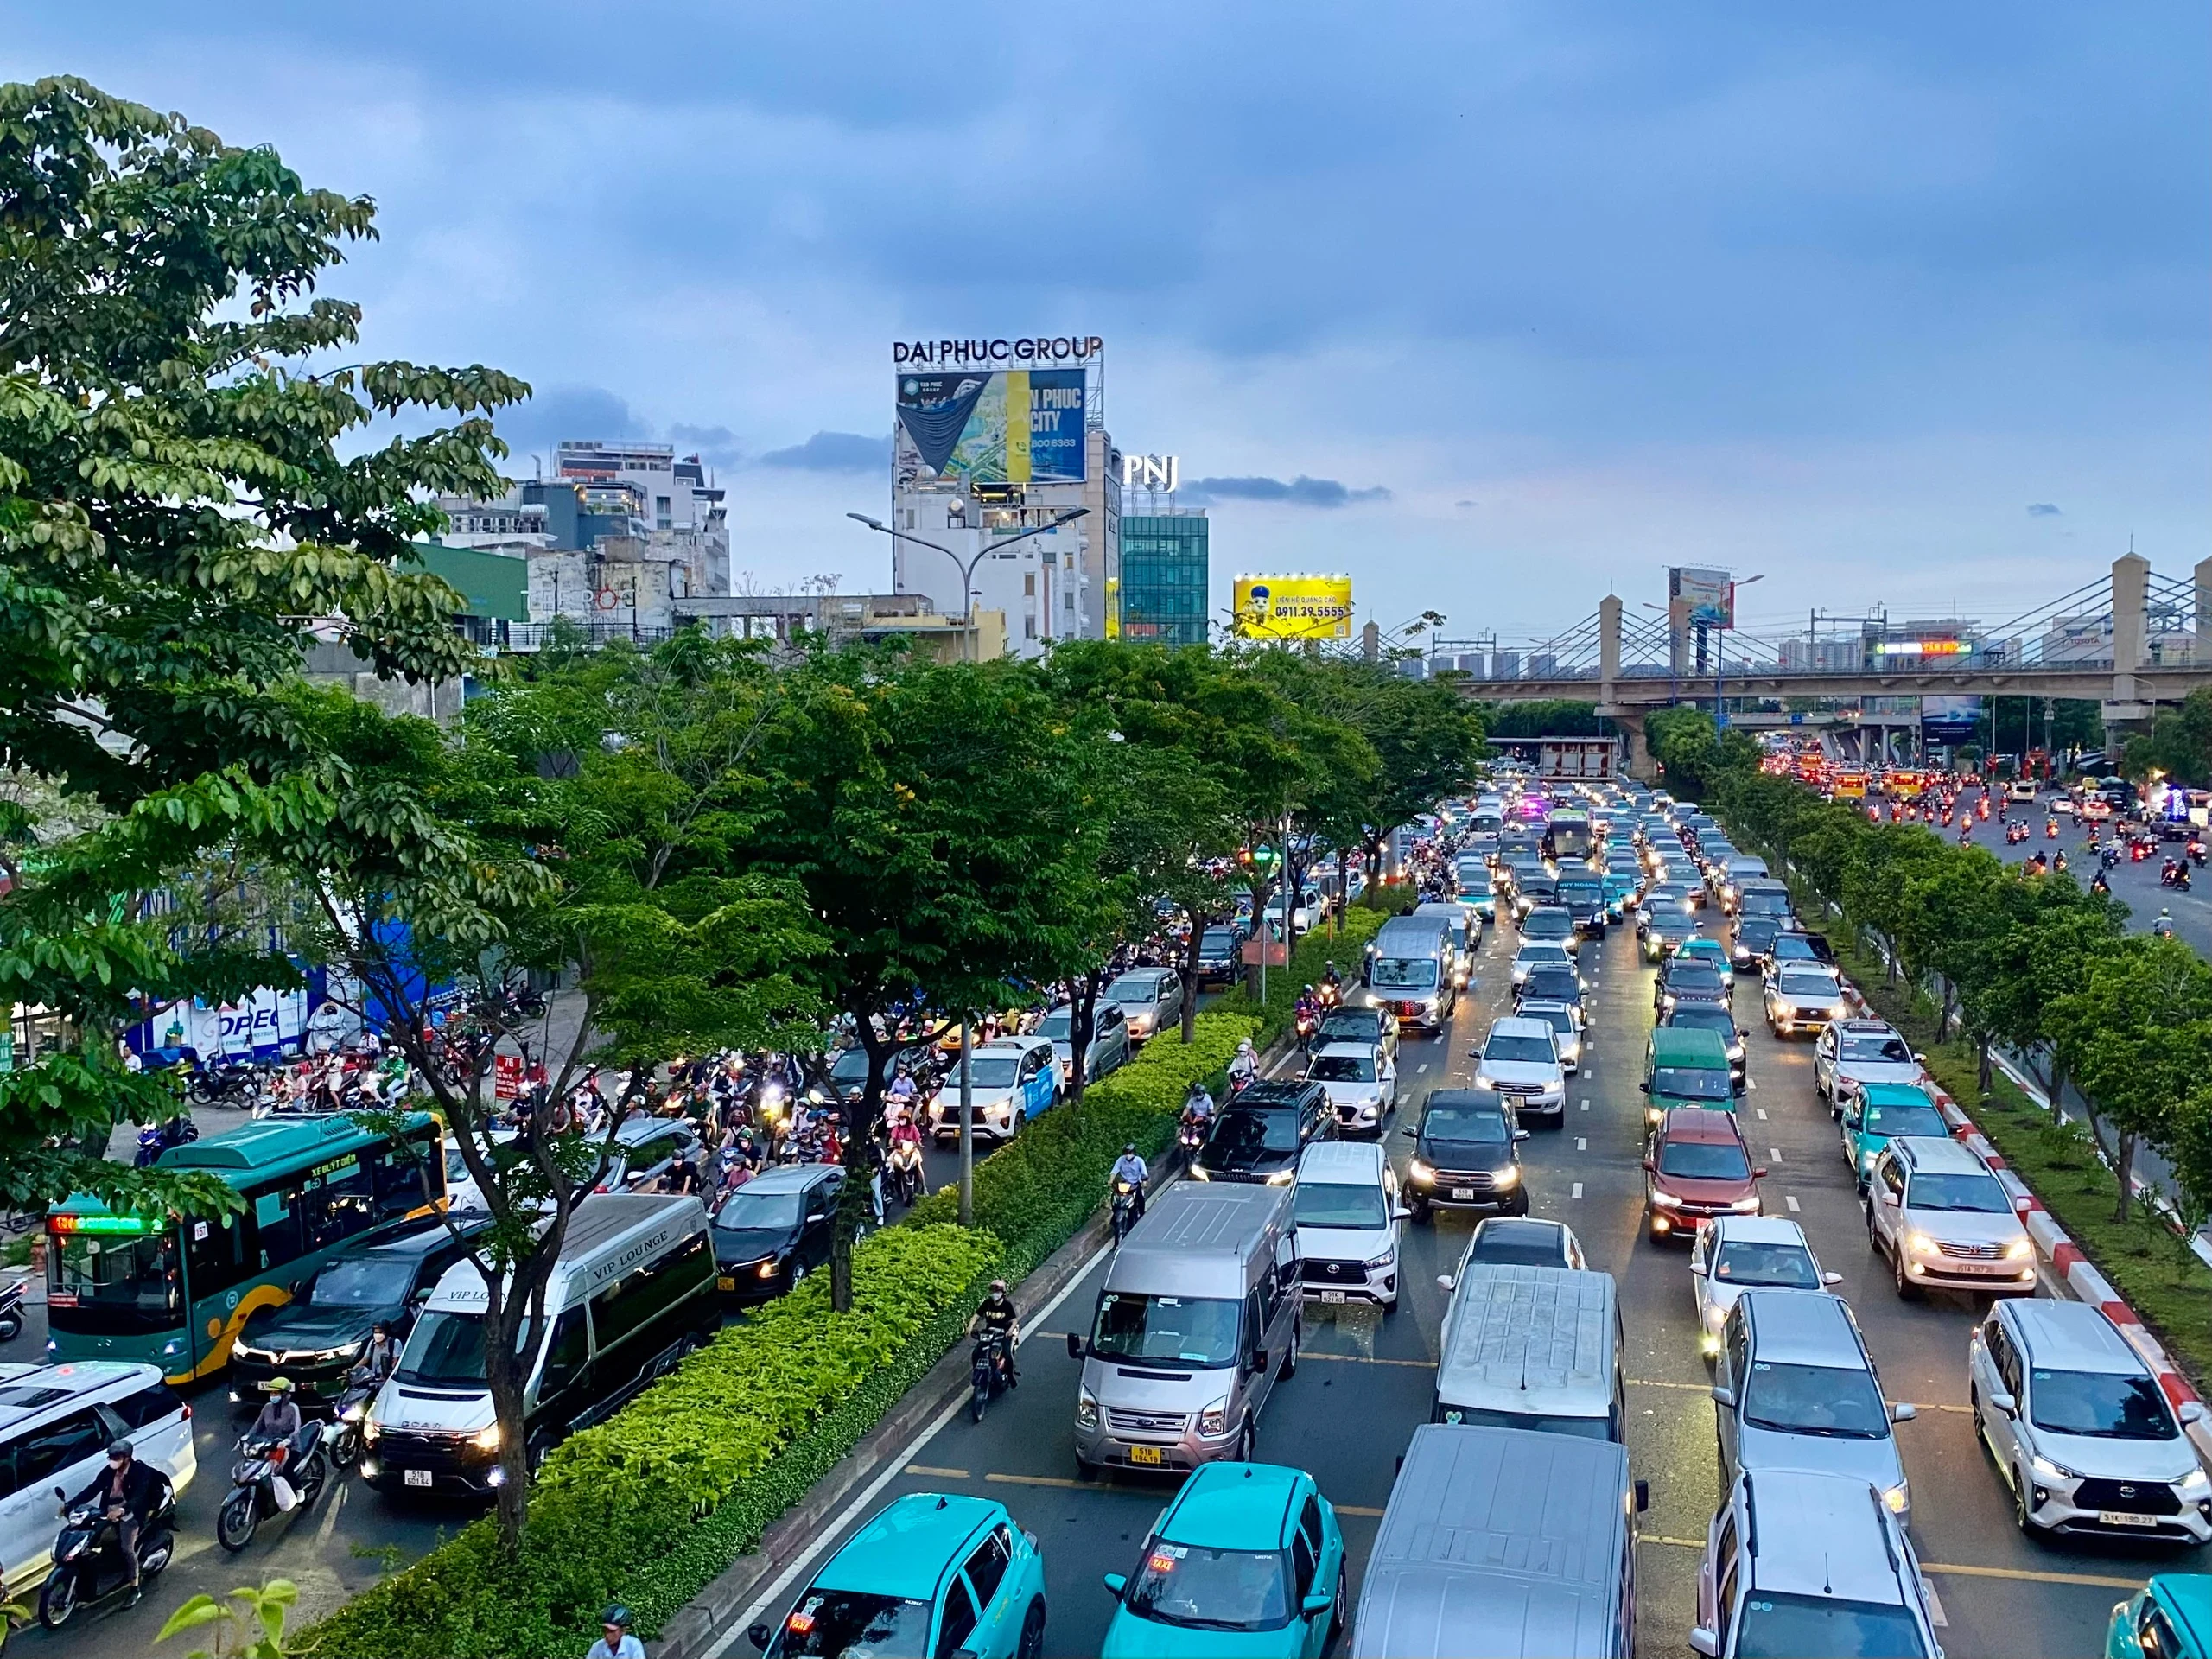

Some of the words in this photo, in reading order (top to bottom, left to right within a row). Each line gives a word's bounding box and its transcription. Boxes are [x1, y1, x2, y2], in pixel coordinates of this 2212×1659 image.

[893, 340, 934, 363] DAI
[941, 339, 1010, 362] PHUC
[1014, 336, 1102, 359] GROUP
[1043, 388, 1082, 410] PHUC
[1030, 410, 1061, 433] CITY
[1052, 438, 1077, 448] 6363
[1122, 455, 1179, 493] PNJ
[1275, 606, 1344, 617] 0911.39.5555
[503, 1057, 514, 1067] 76
[312, 1166, 321, 1177] XE
[594, 1262, 616, 1280] VIP
[619, 1230, 668, 1266] LOUNGE
[450, 1291, 471, 1300] VIP
[1139, 1447, 1153, 1456] 51B
[1151, 1558, 1173, 1571] TAXI
[790, 1618, 810, 1631] TAXI
